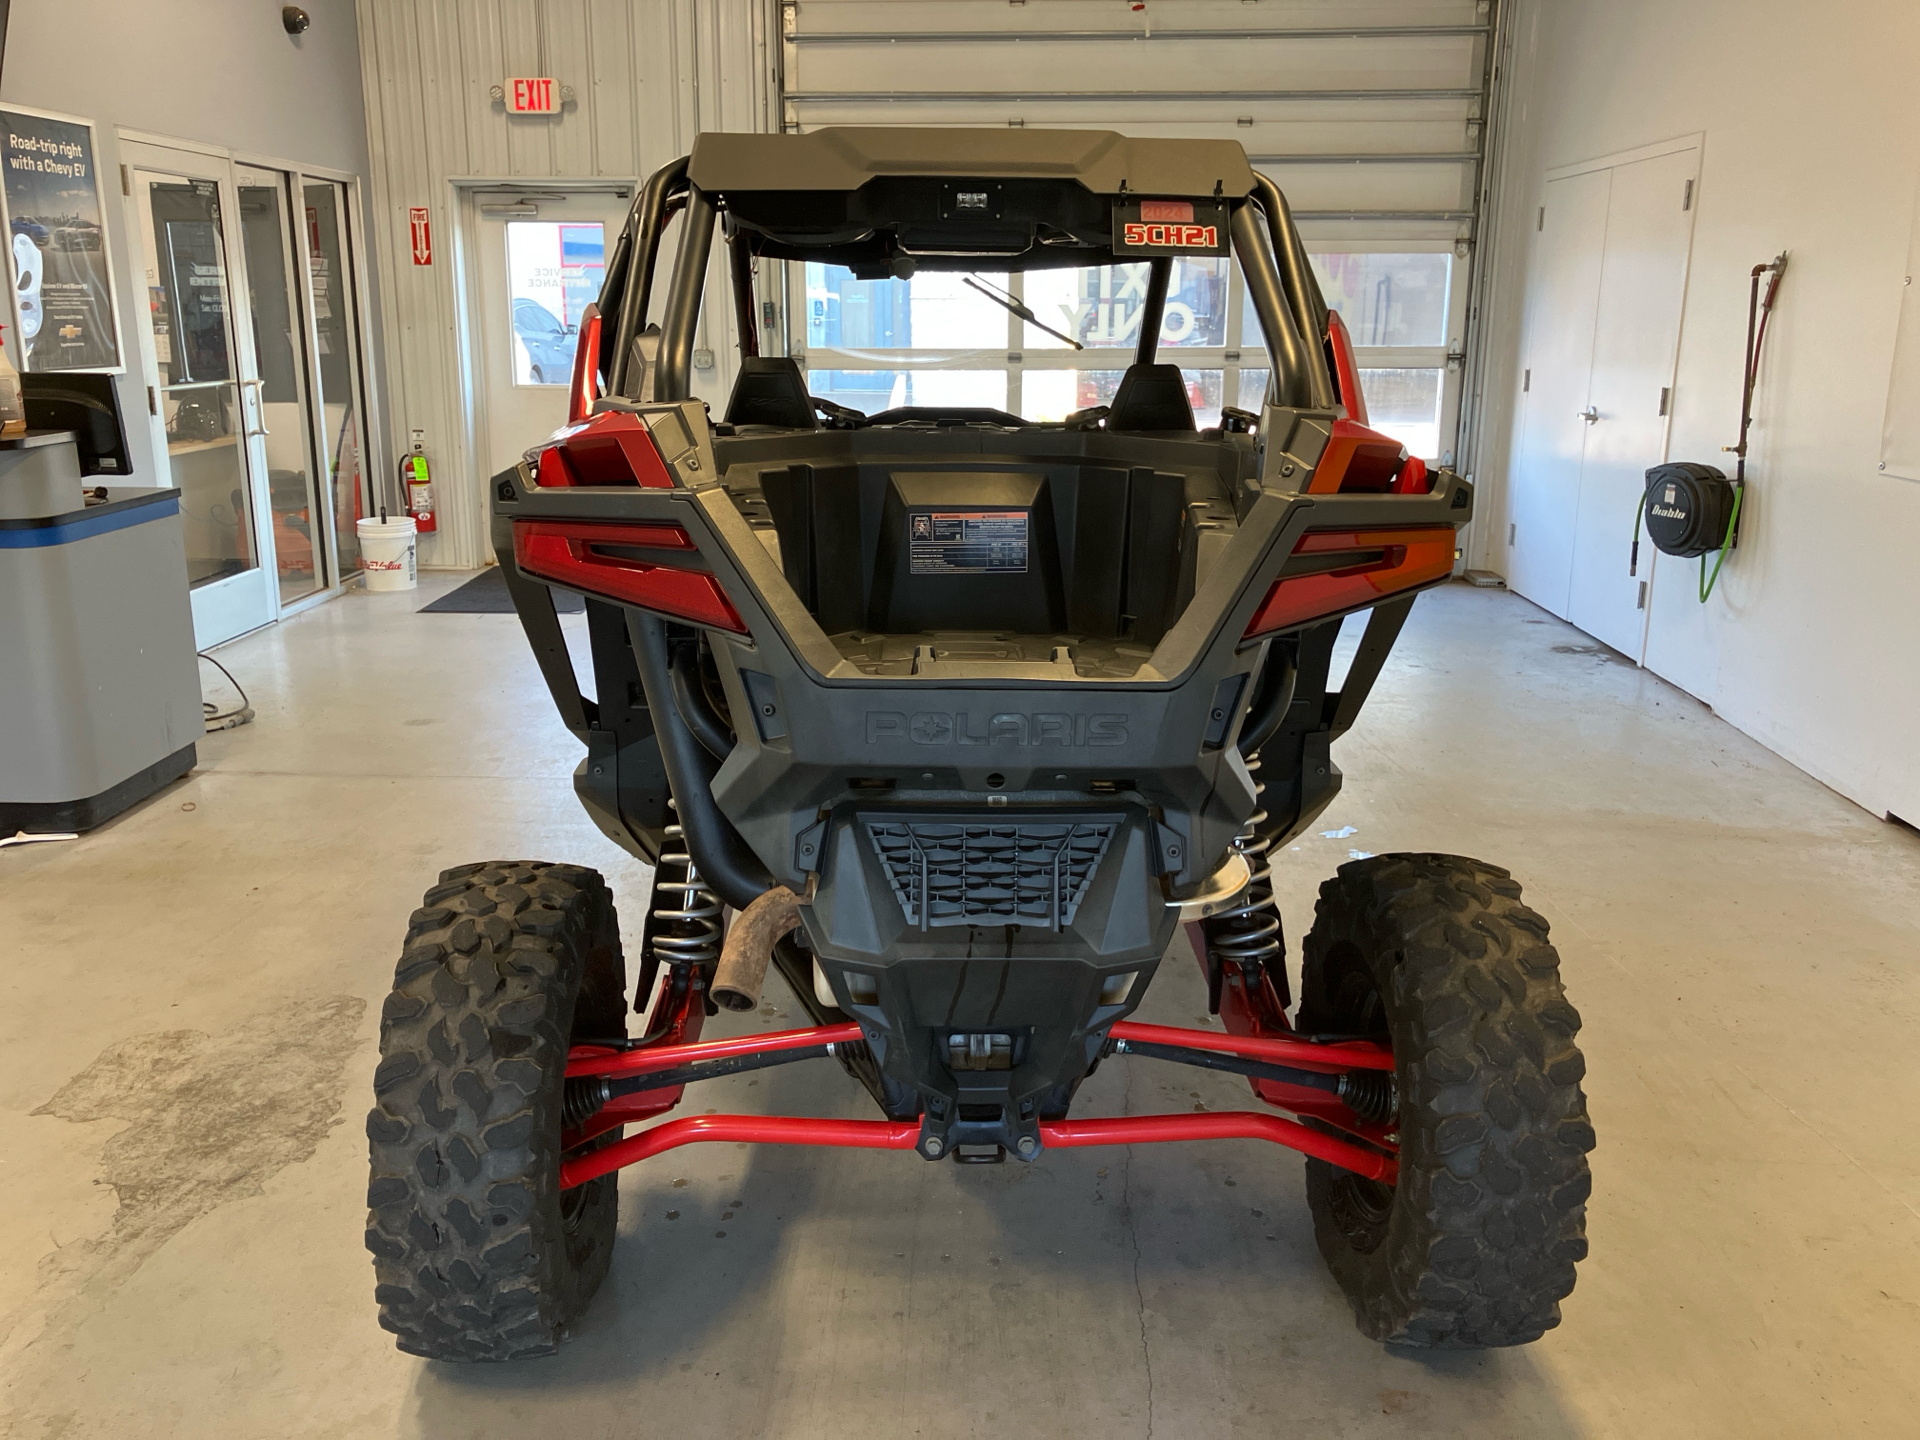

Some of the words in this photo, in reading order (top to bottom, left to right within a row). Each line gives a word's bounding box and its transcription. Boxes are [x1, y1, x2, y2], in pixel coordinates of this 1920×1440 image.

[514, 79, 552, 111] EXIT
[10, 134, 58, 157] Road-trip
[59, 141, 83, 159] right
[10, 155, 35, 171] with
[36, 161, 43, 172] a
[44, 159, 72, 178] Chevy
[73, 163, 85, 177] EV
[413, 213, 426, 221] FIRE
[1142, 205, 1184, 219] 2024
[1125, 223, 1218, 248] 5CH21
[1651, 504, 1686, 519] Diablo
[866, 711, 1129, 746] POLARIS
